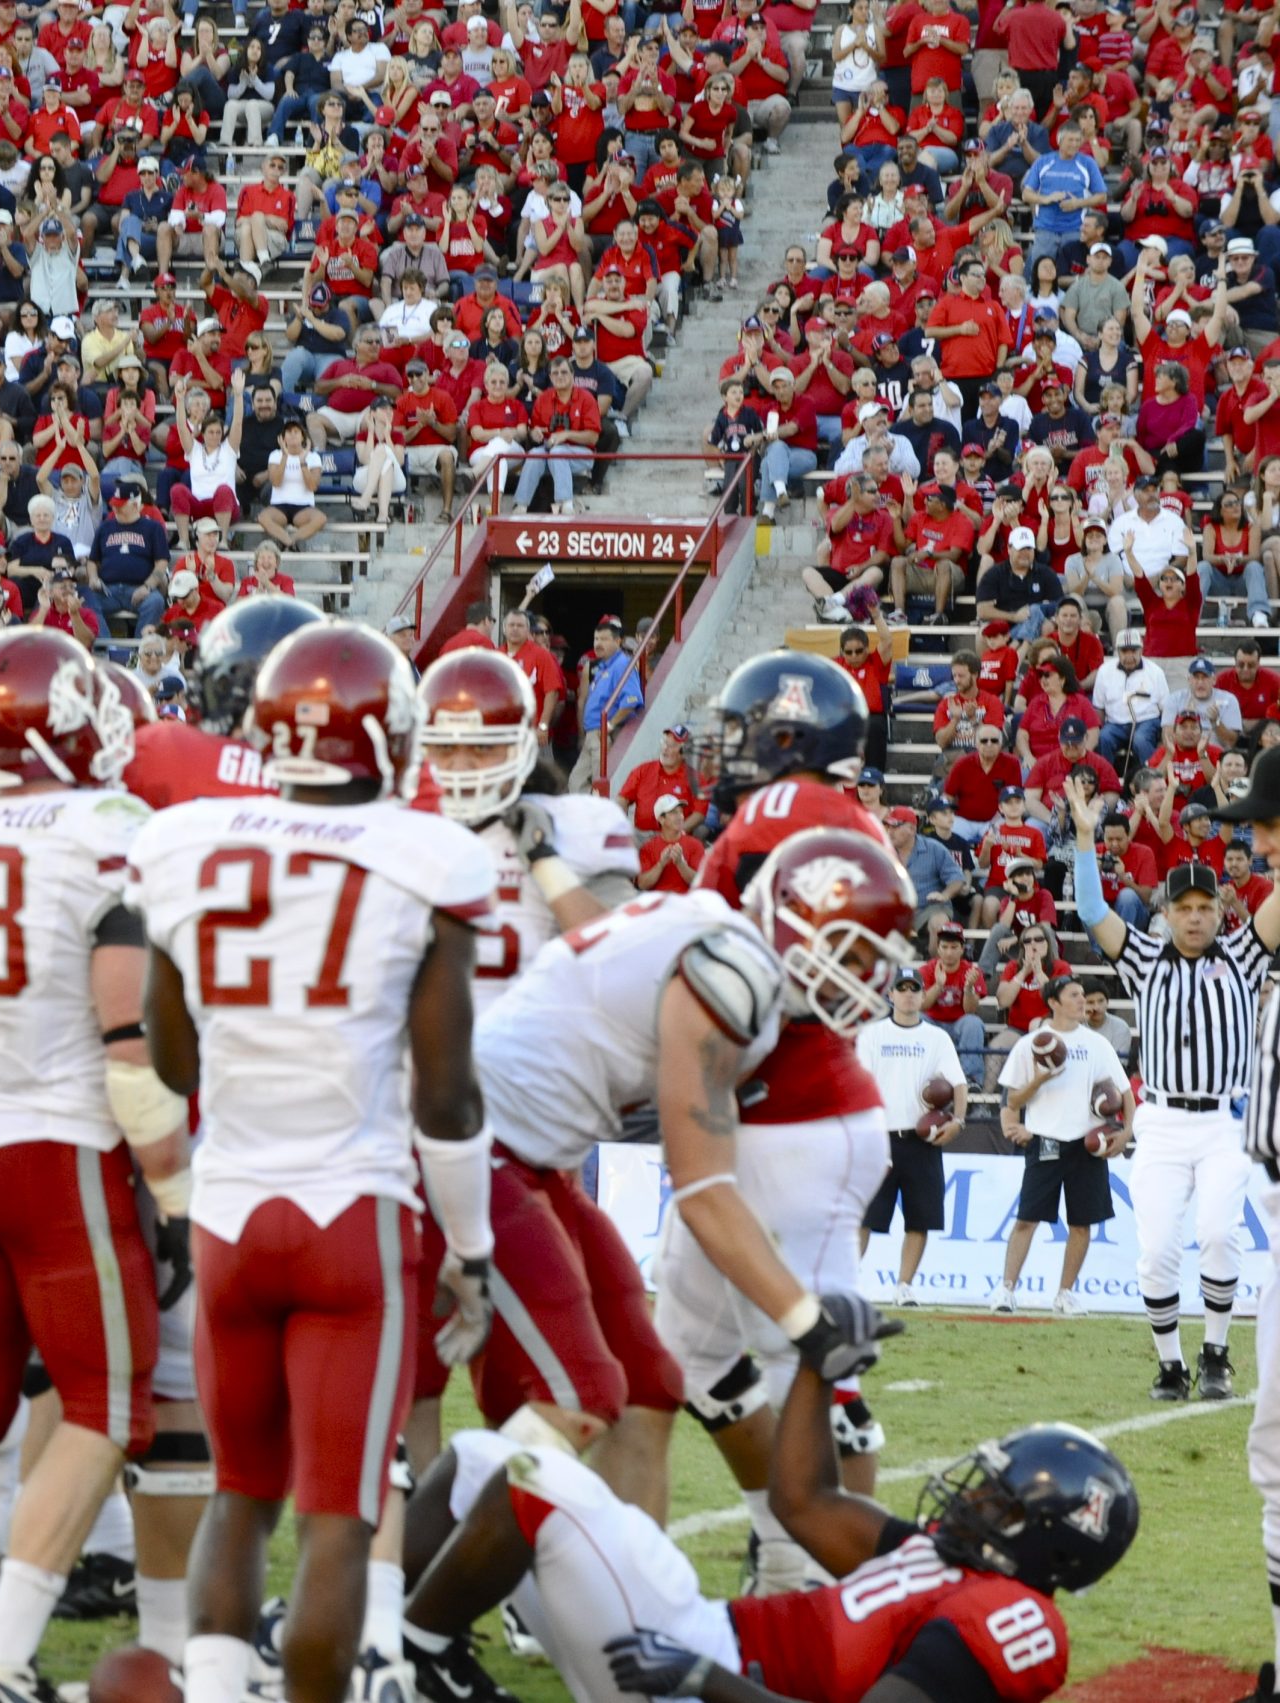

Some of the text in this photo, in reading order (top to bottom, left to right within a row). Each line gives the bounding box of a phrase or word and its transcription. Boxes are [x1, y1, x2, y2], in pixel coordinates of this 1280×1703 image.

[878, 381, 903, 411] 10
[537, 530, 675, 559] 23 SECTION 24
[271, 722, 319, 761] 27
[217, 744, 280, 790] GR
[196, 847, 369, 1009] 27
[983, 1275, 1045, 1298] yu
[985, 1597, 1057, 1674] 88
